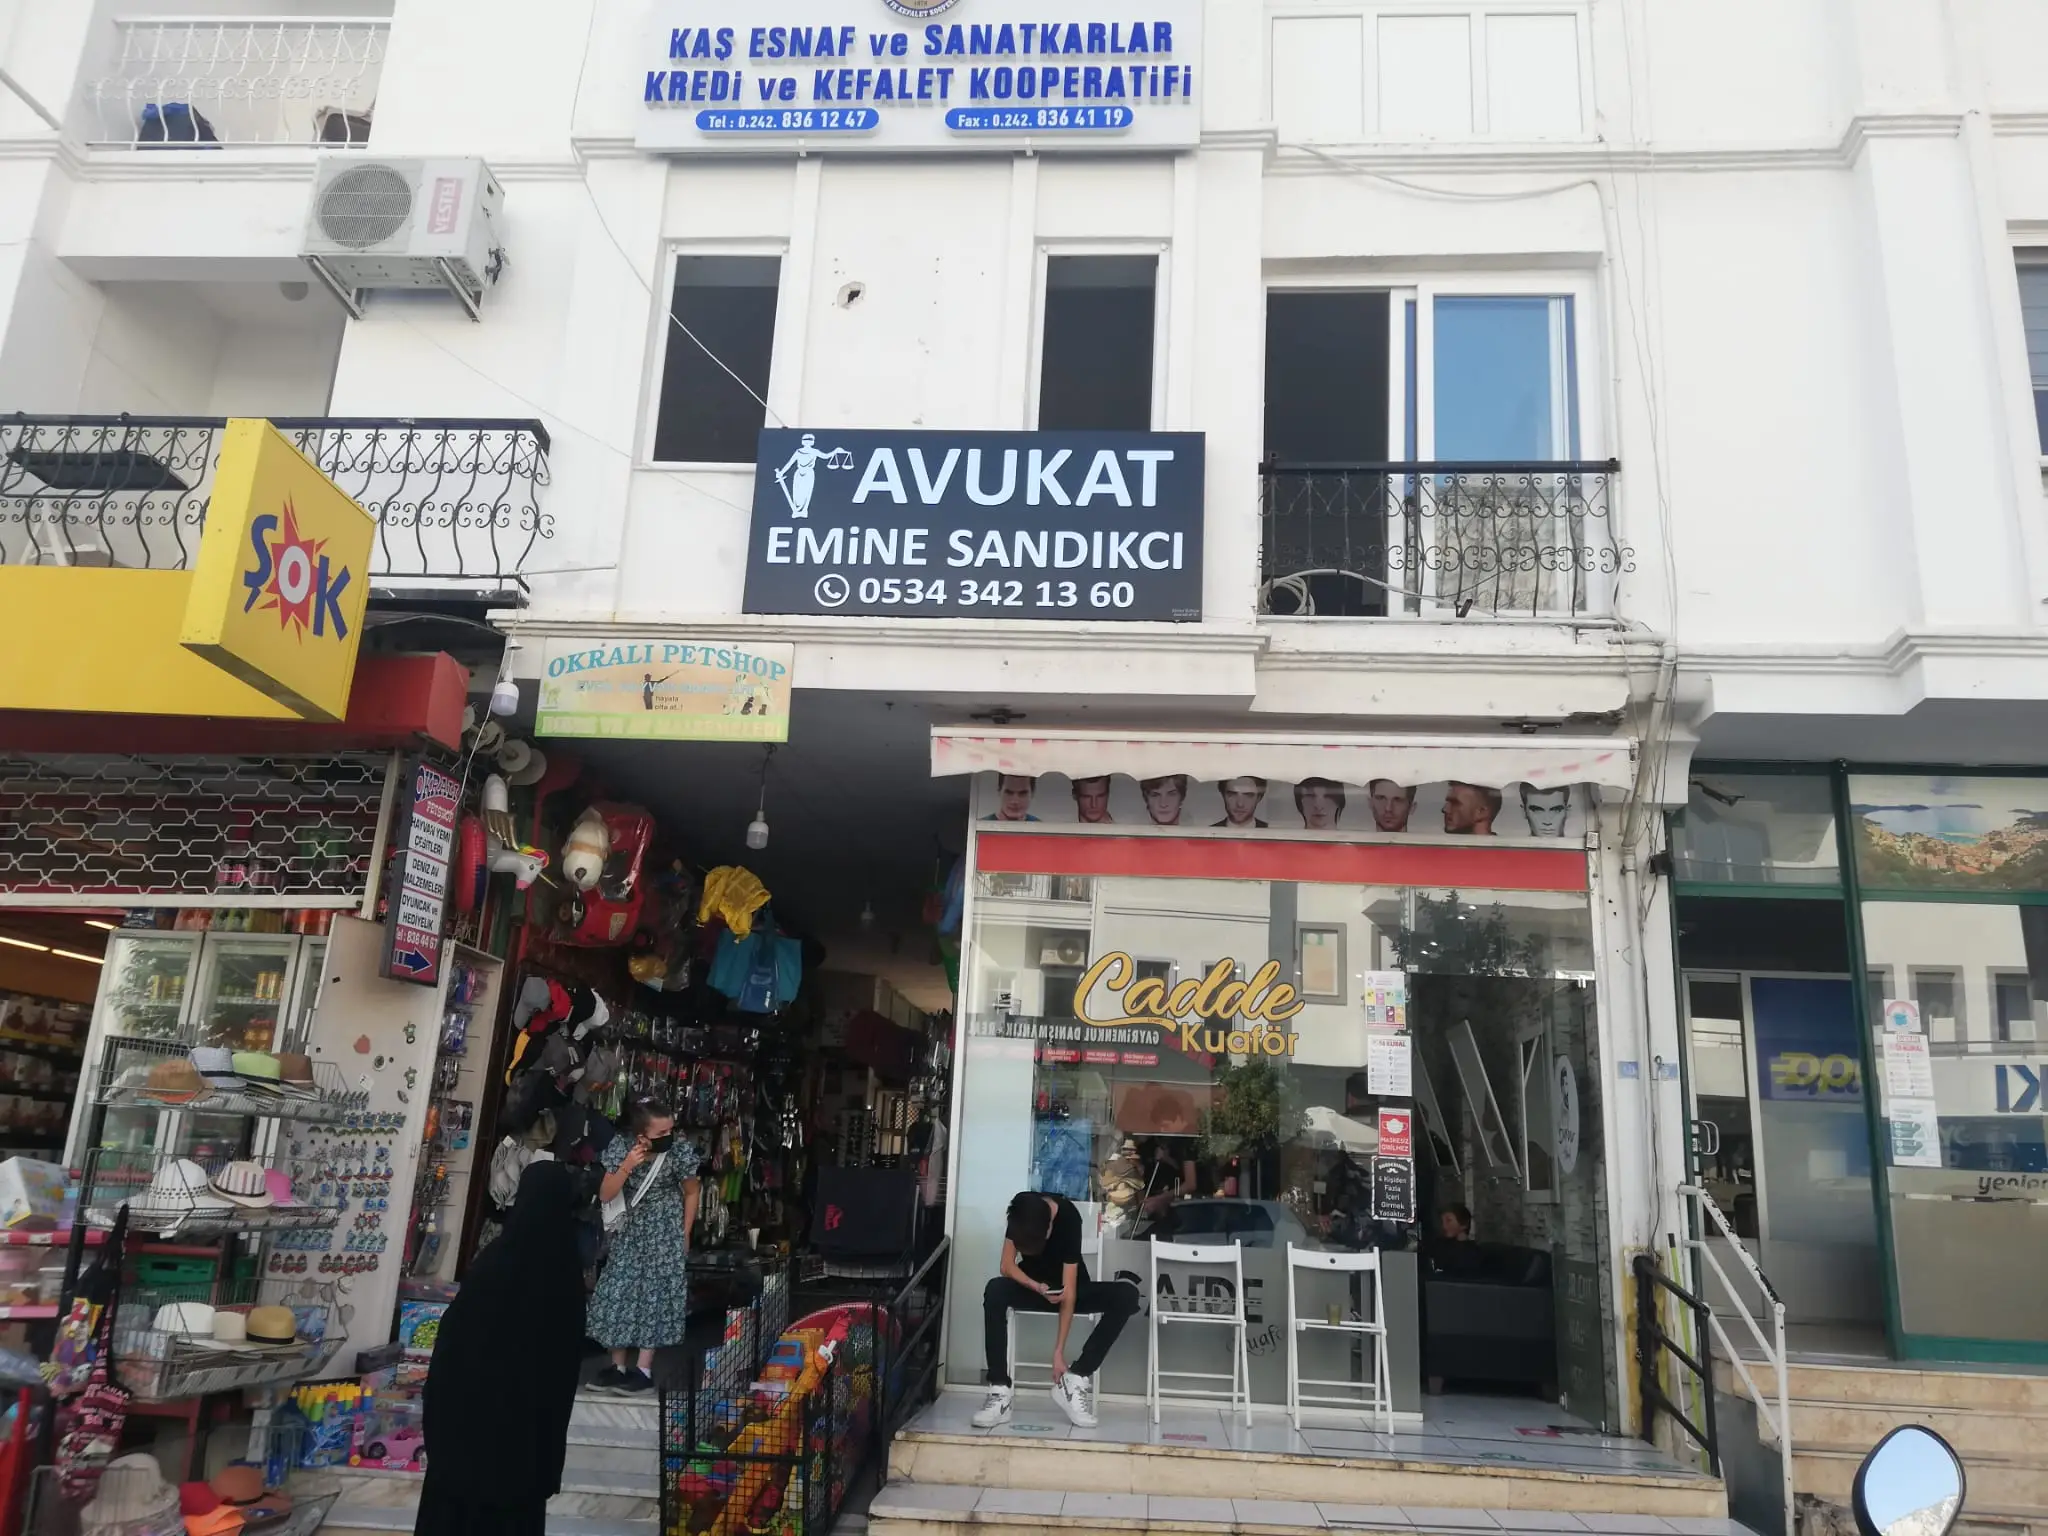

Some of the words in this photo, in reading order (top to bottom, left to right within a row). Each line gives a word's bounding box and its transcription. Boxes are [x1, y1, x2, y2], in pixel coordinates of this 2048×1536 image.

[669, 28, 735, 60] KAŞ
[748, 26, 856, 57] ESNAF
[870, 31, 909, 56] ve
[924, 21, 1174, 55] SANATKARLAR
[759, 75, 796, 100] ve
[813, 67, 955, 100] KEFALET
[708, 113, 729, 128] Tel
[782, 112, 815, 128] 836
[819, 112, 841, 127] 12
[844, 111, 868, 127] 47
[958, 113, 980, 127] Fax
[1037, 110, 1070, 127] 836
[1074, 110, 1099, 126] 41
[1103, 109, 1124, 126] 19
[434, 179, 458, 233] VESTEL
[852, 447, 1175, 507] AVUKAT
[946, 529, 1184, 570] SANDIKCI
[243, 513, 351, 642] ŞOK
[858, 577, 947, 606] 0534
[958, 580, 1024, 607] 342
[1035, 581, 1078, 607] 13
[1089, 581, 1135, 608] 60
[548, 644, 653, 678] OKRALI
[662, 644, 787, 682] PETSHOP
[411, 815, 436, 838] HAYVAN
[401, 893, 432, 914] OYUNCAK
[1072, 950, 1306, 1033] Cadde
[1181, 1022, 1300, 1057] Kuaför
